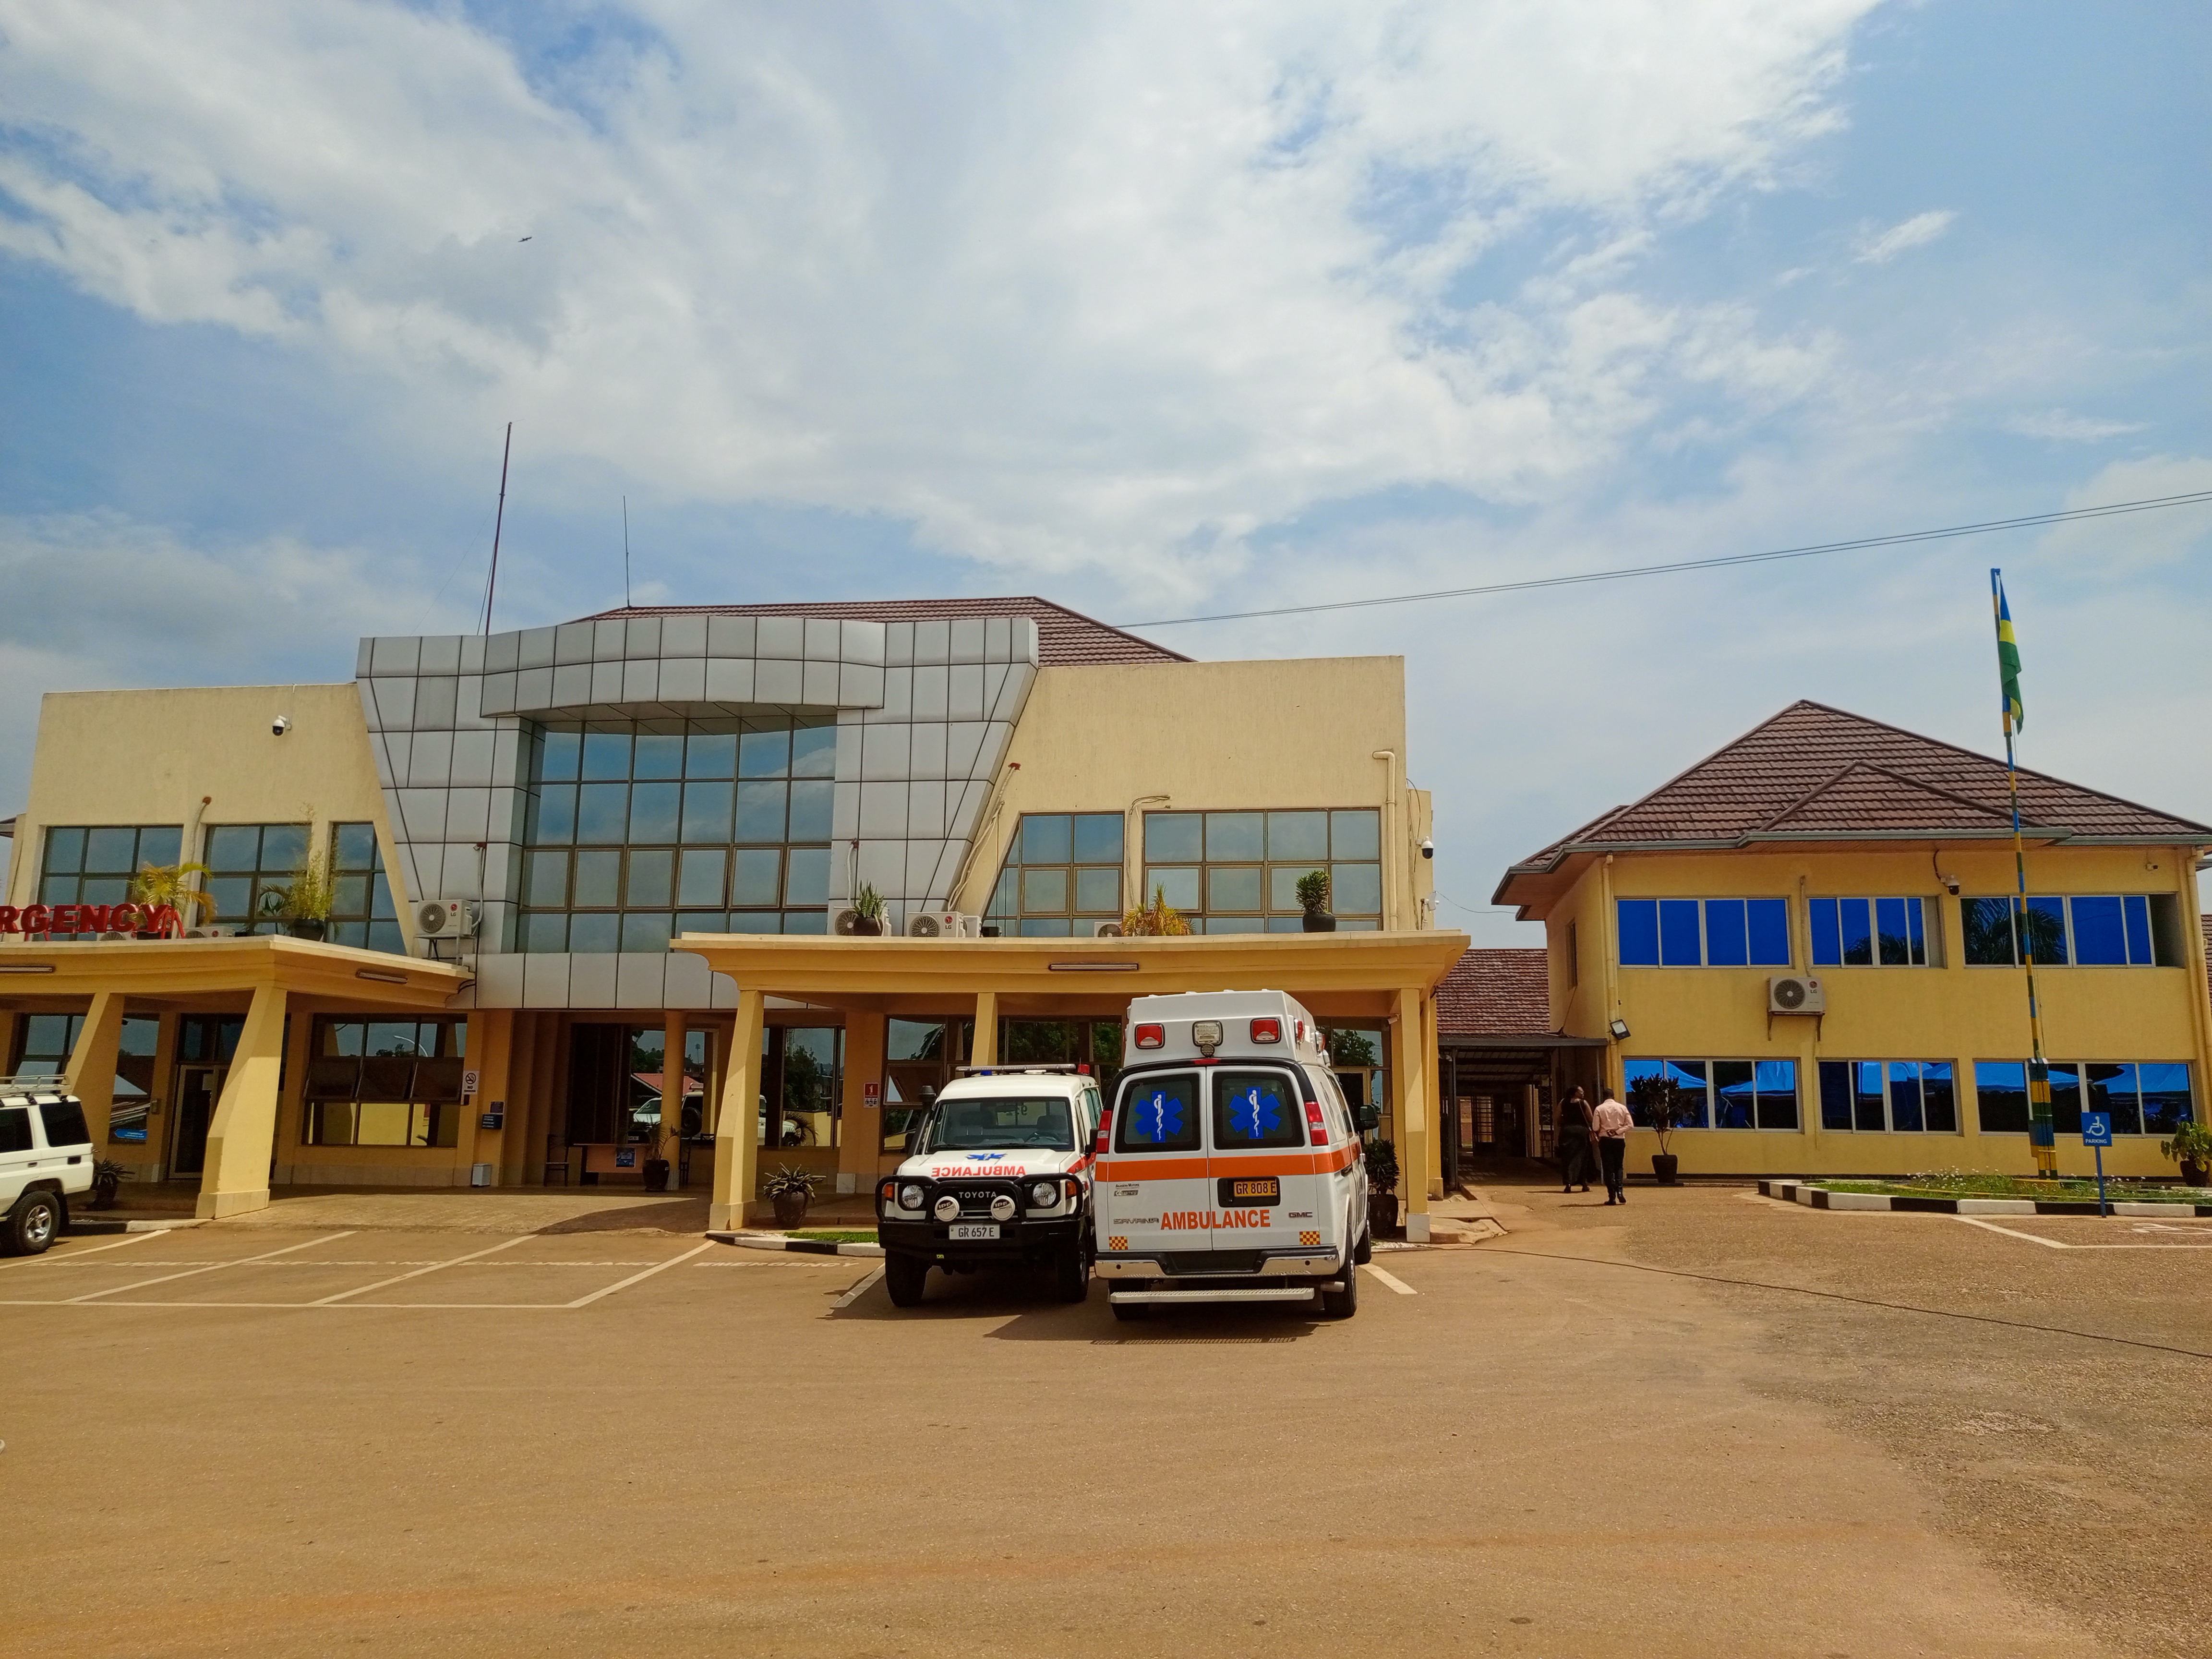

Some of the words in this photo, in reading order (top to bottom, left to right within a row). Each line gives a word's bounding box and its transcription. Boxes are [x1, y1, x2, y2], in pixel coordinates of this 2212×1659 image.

[1236, 1183, 1248, 1194] GR
[1250, 1182, 1268, 1194] 808
[1271, 1182, 1276, 1193] E
[1161, 1209, 1271, 1230] AMBULANCE
[959, 1226, 969, 1238] GR
[972, 1227, 987, 1237] 657
[989, 1227, 994, 1237] E
